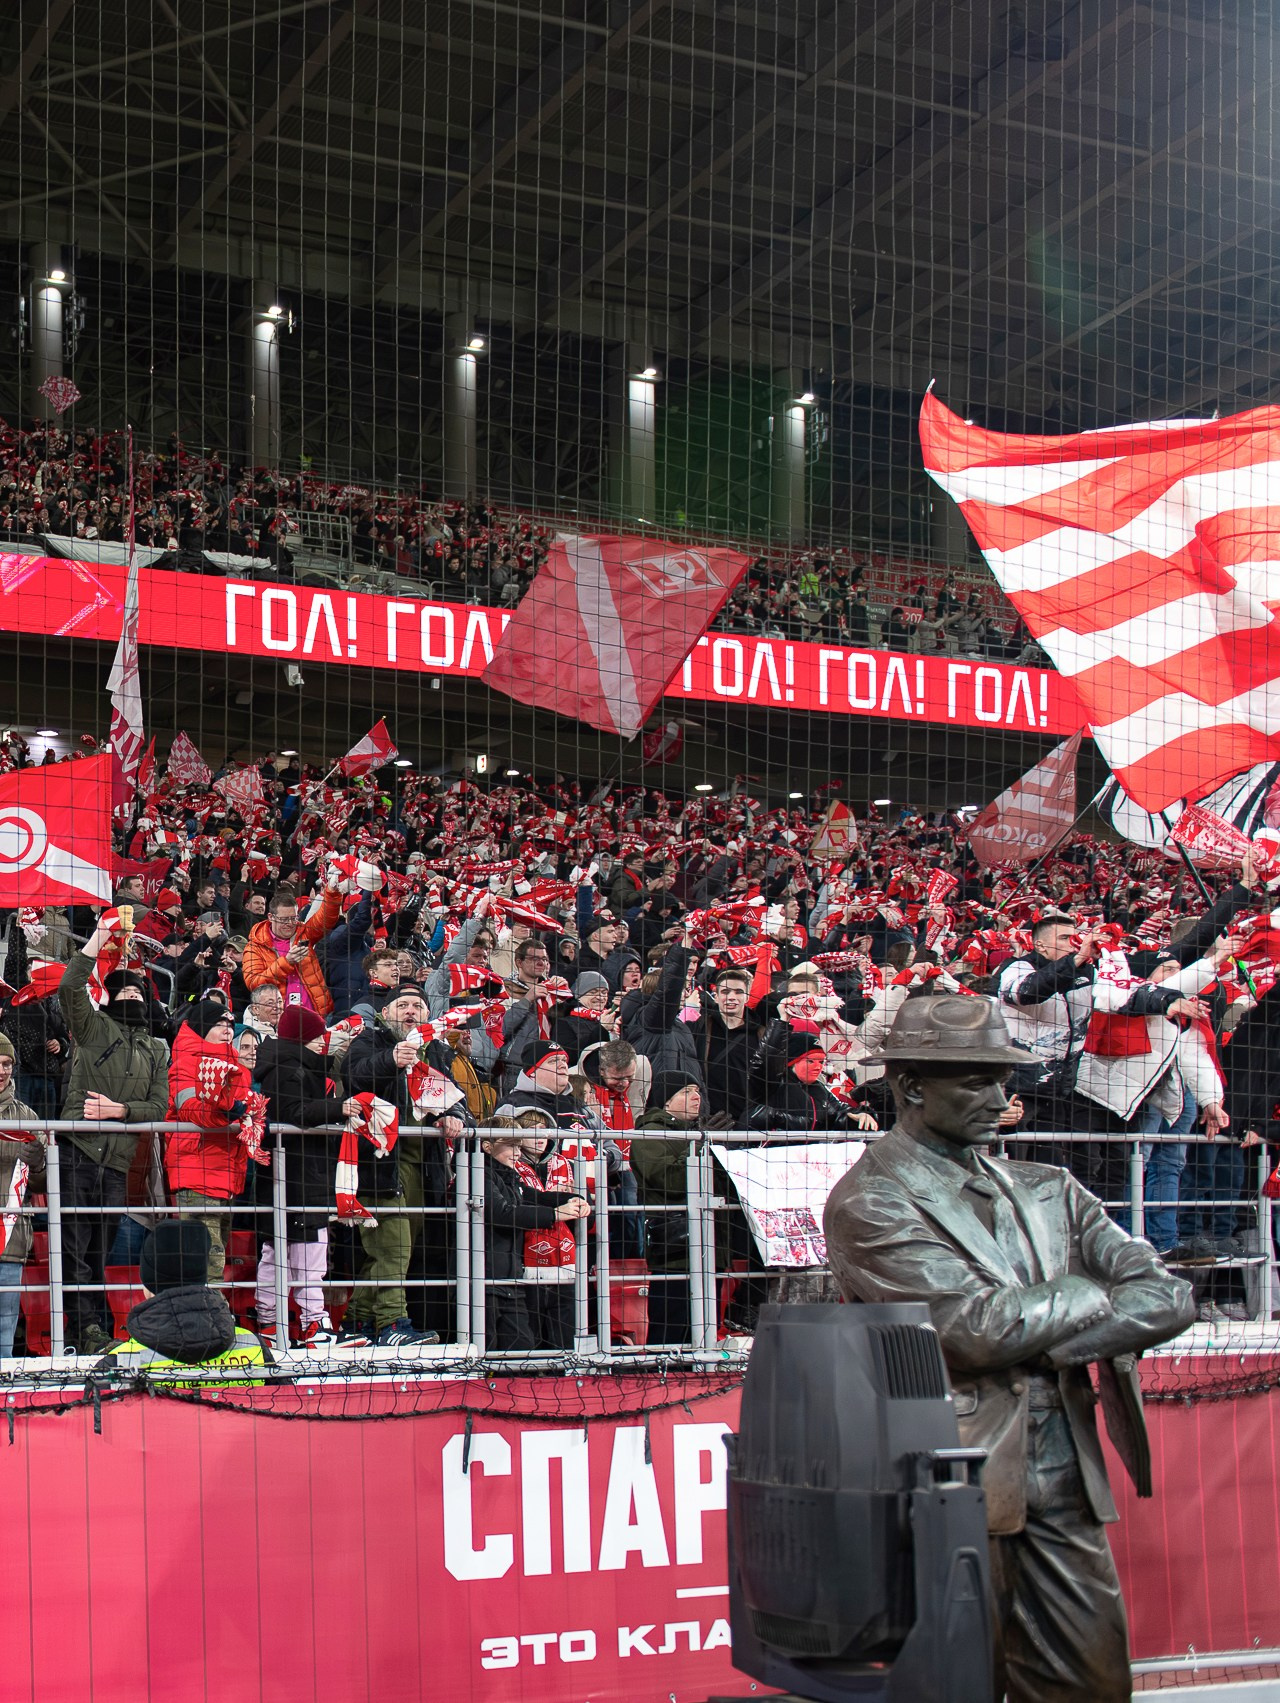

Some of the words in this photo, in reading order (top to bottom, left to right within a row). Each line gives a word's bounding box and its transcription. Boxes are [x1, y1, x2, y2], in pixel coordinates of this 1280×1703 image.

[226, 584, 357, 658] ГОЛ!
[820, 649, 924, 715] ГОЛ!
[949, 663, 1048, 727] ГОЛ!
[481, 1629, 597, 1670] ЭТО
